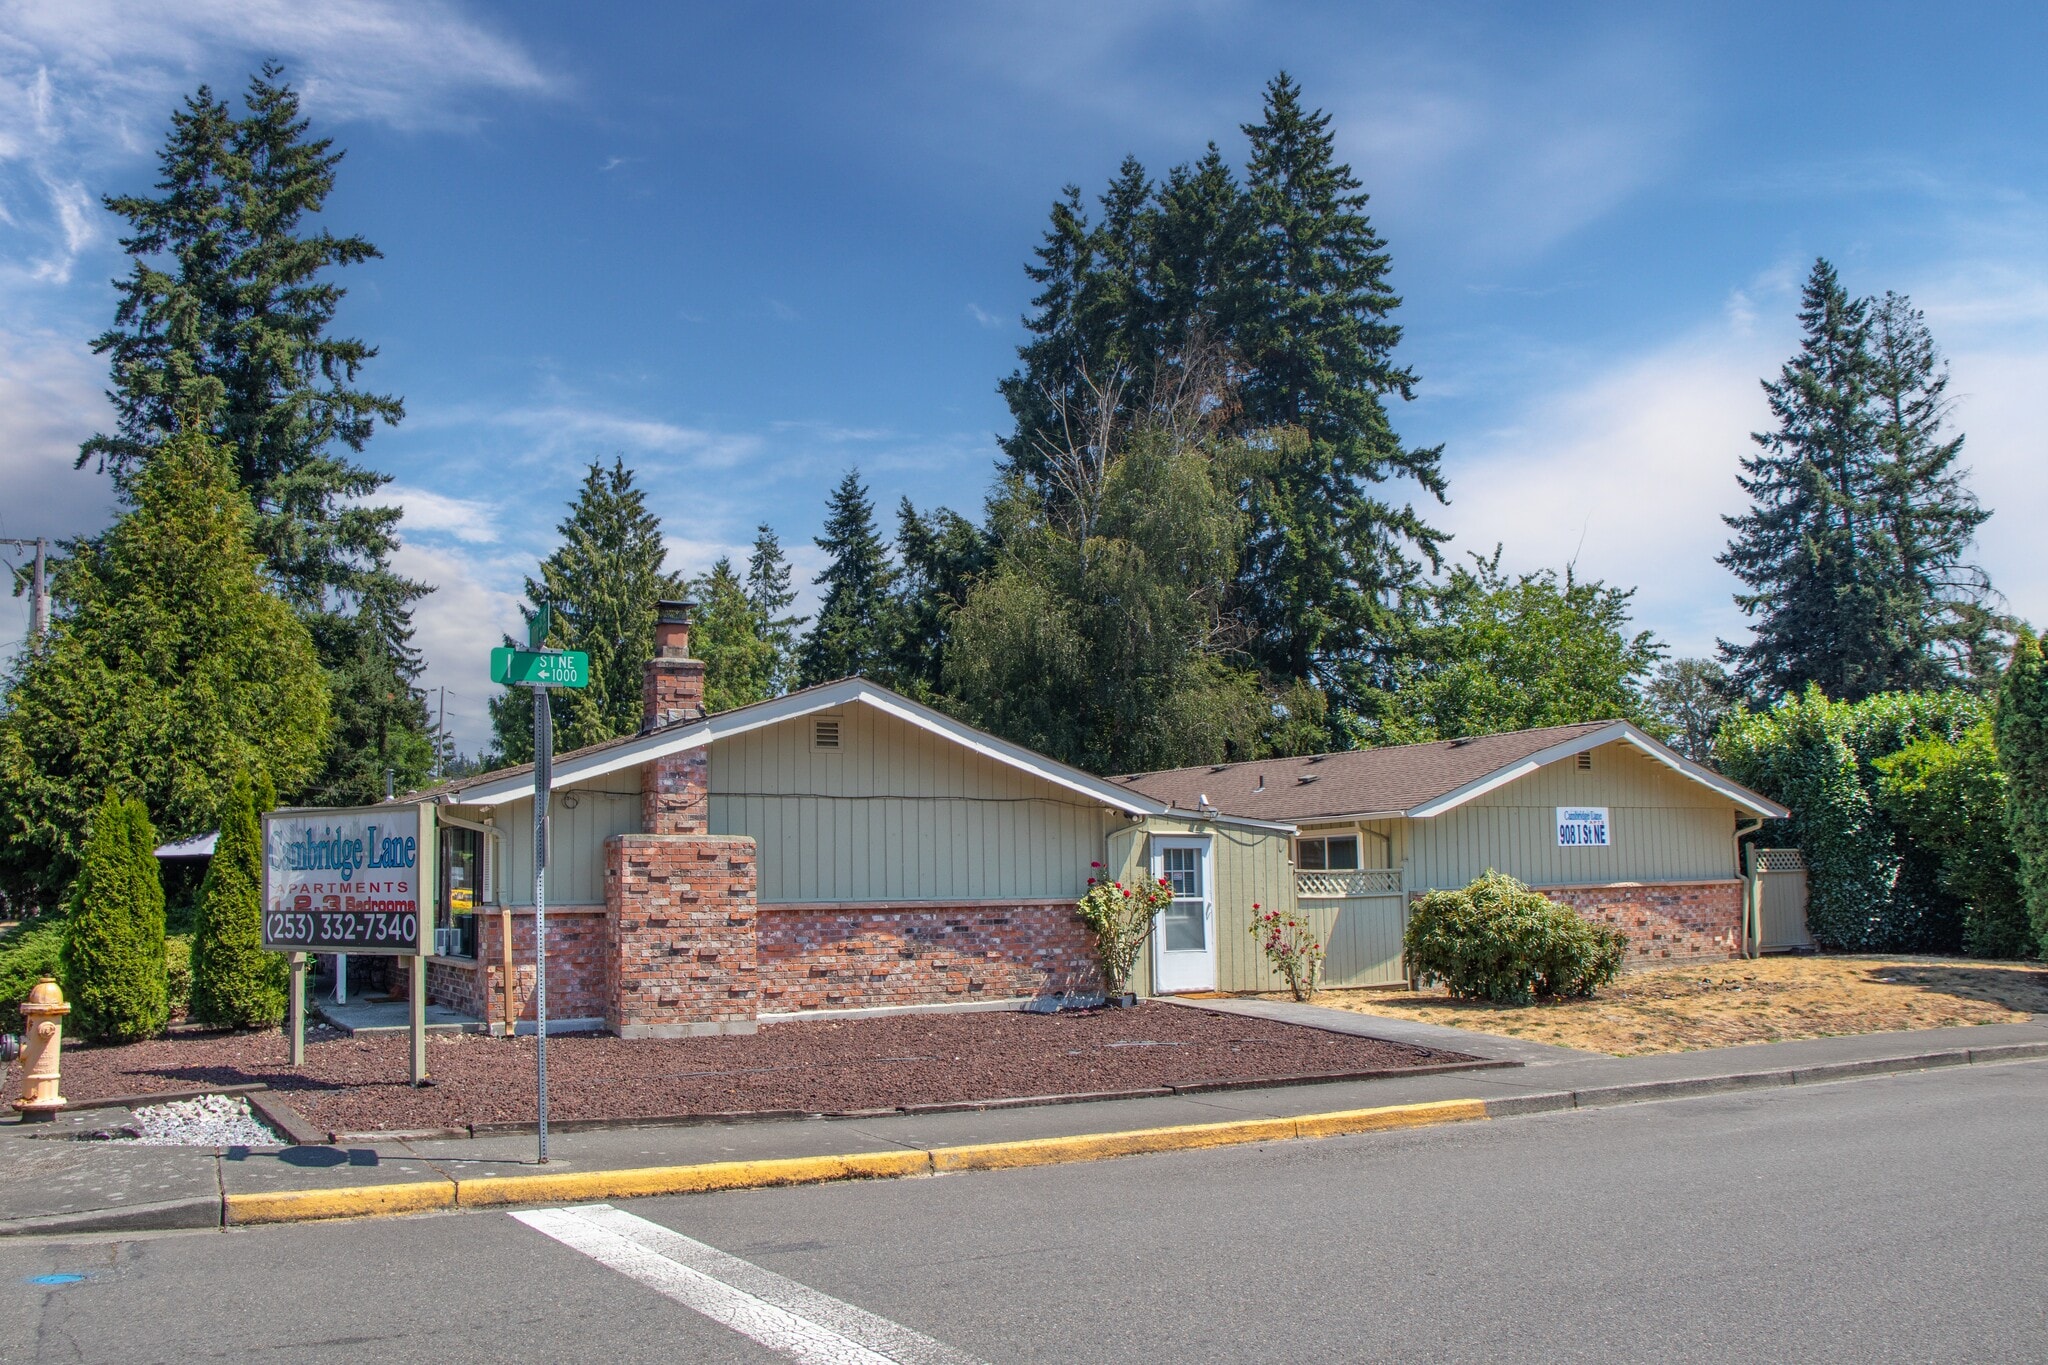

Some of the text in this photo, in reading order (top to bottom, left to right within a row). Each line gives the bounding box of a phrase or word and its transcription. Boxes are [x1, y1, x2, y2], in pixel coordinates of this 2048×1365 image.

[540, 656, 555, 667] ST
[559, 656, 574, 669] NE
[552, 669, 577, 681] 1000
[1560, 825, 1605, 844] 908 I St NE
[368, 826, 415, 868] Lane
[276, 882, 408, 894] APARTMENTS
[345, 896, 415, 911] Bedrooms
[267, 914, 416, 943] (253) 332-7340
